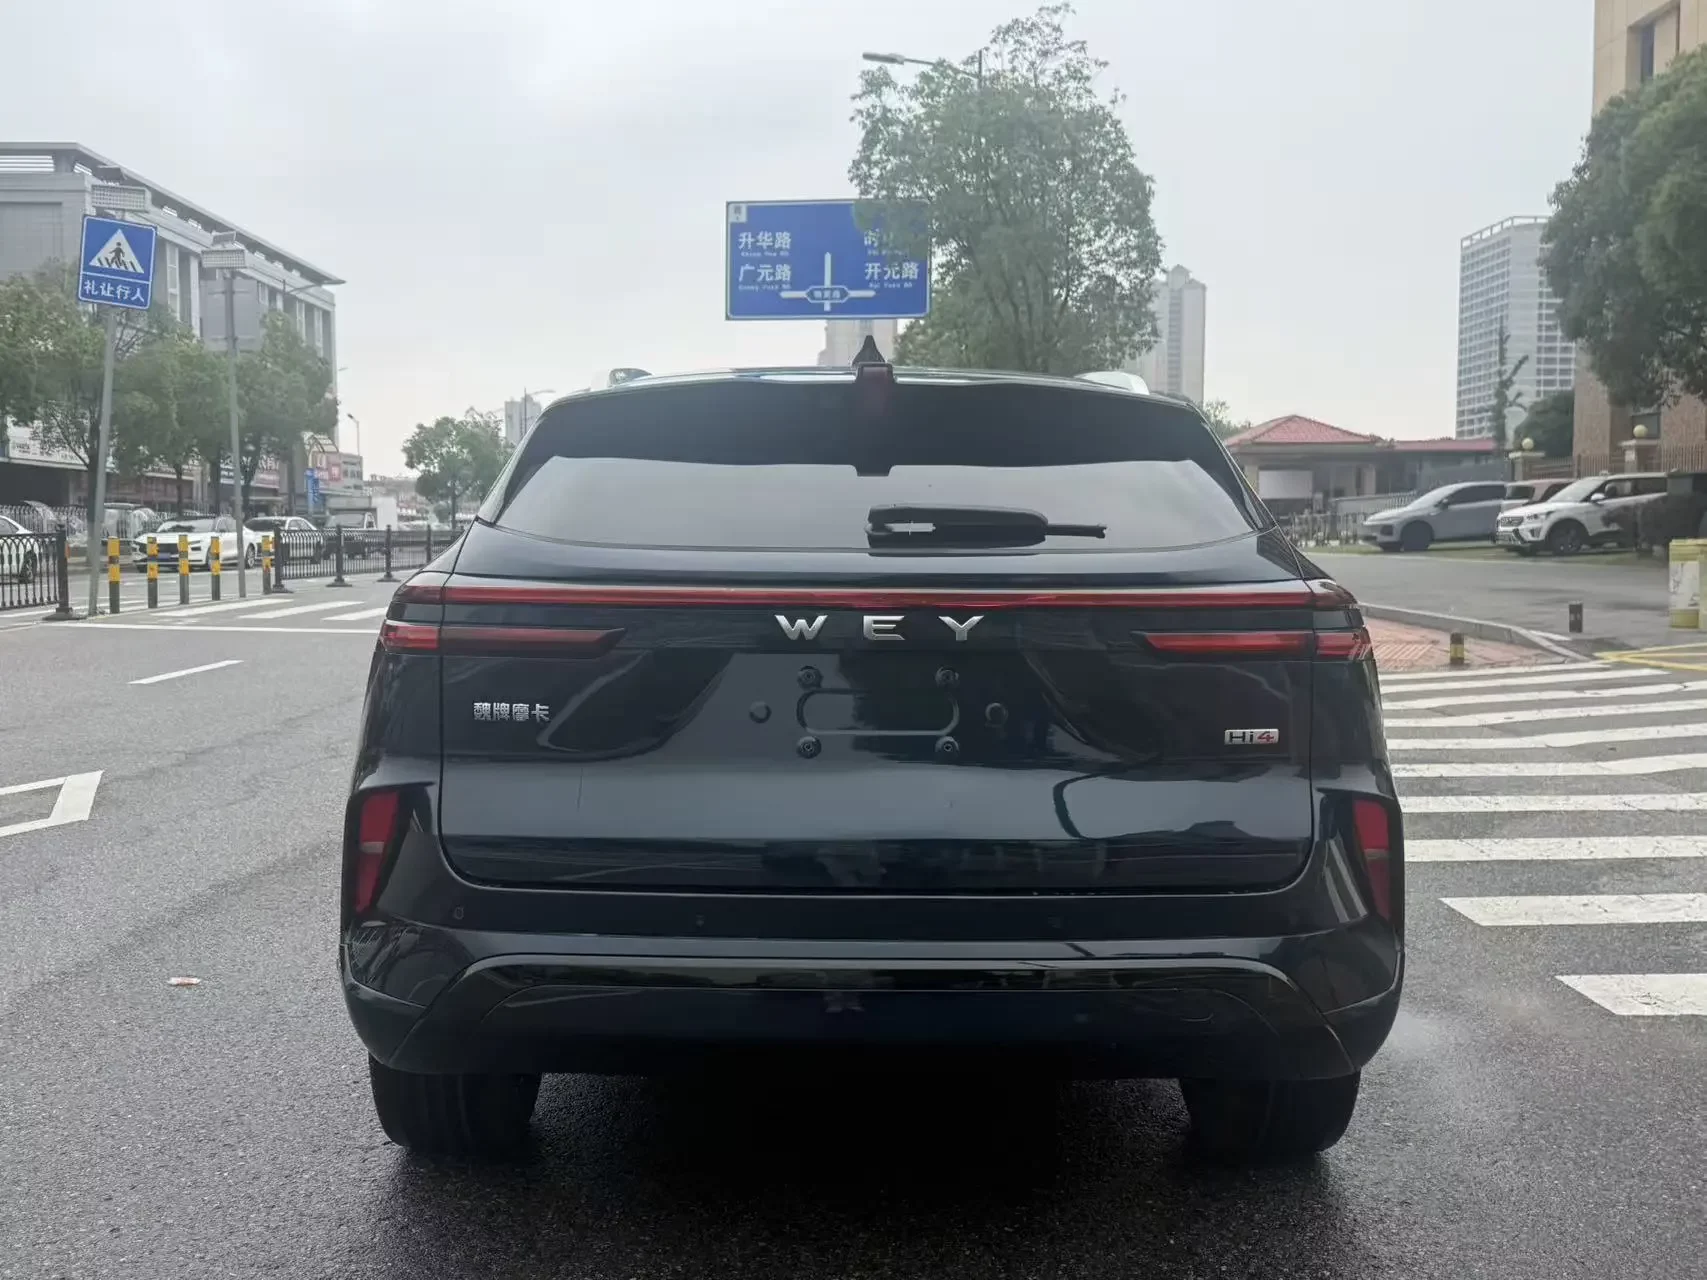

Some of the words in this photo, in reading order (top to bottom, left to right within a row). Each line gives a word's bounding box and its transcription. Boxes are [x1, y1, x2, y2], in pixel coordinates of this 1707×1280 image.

[738, 230, 791, 250] 升华路
[738, 263, 791, 282] 广元路
[864, 262, 919, 280] 开元路
[83, 280, 145, 303] 礼让行人
[774, 614, 985, 641] WEY
[473, 702, 550, 722] 魏牌摩卡
[1229, 731, 1275, 743] Hi4
